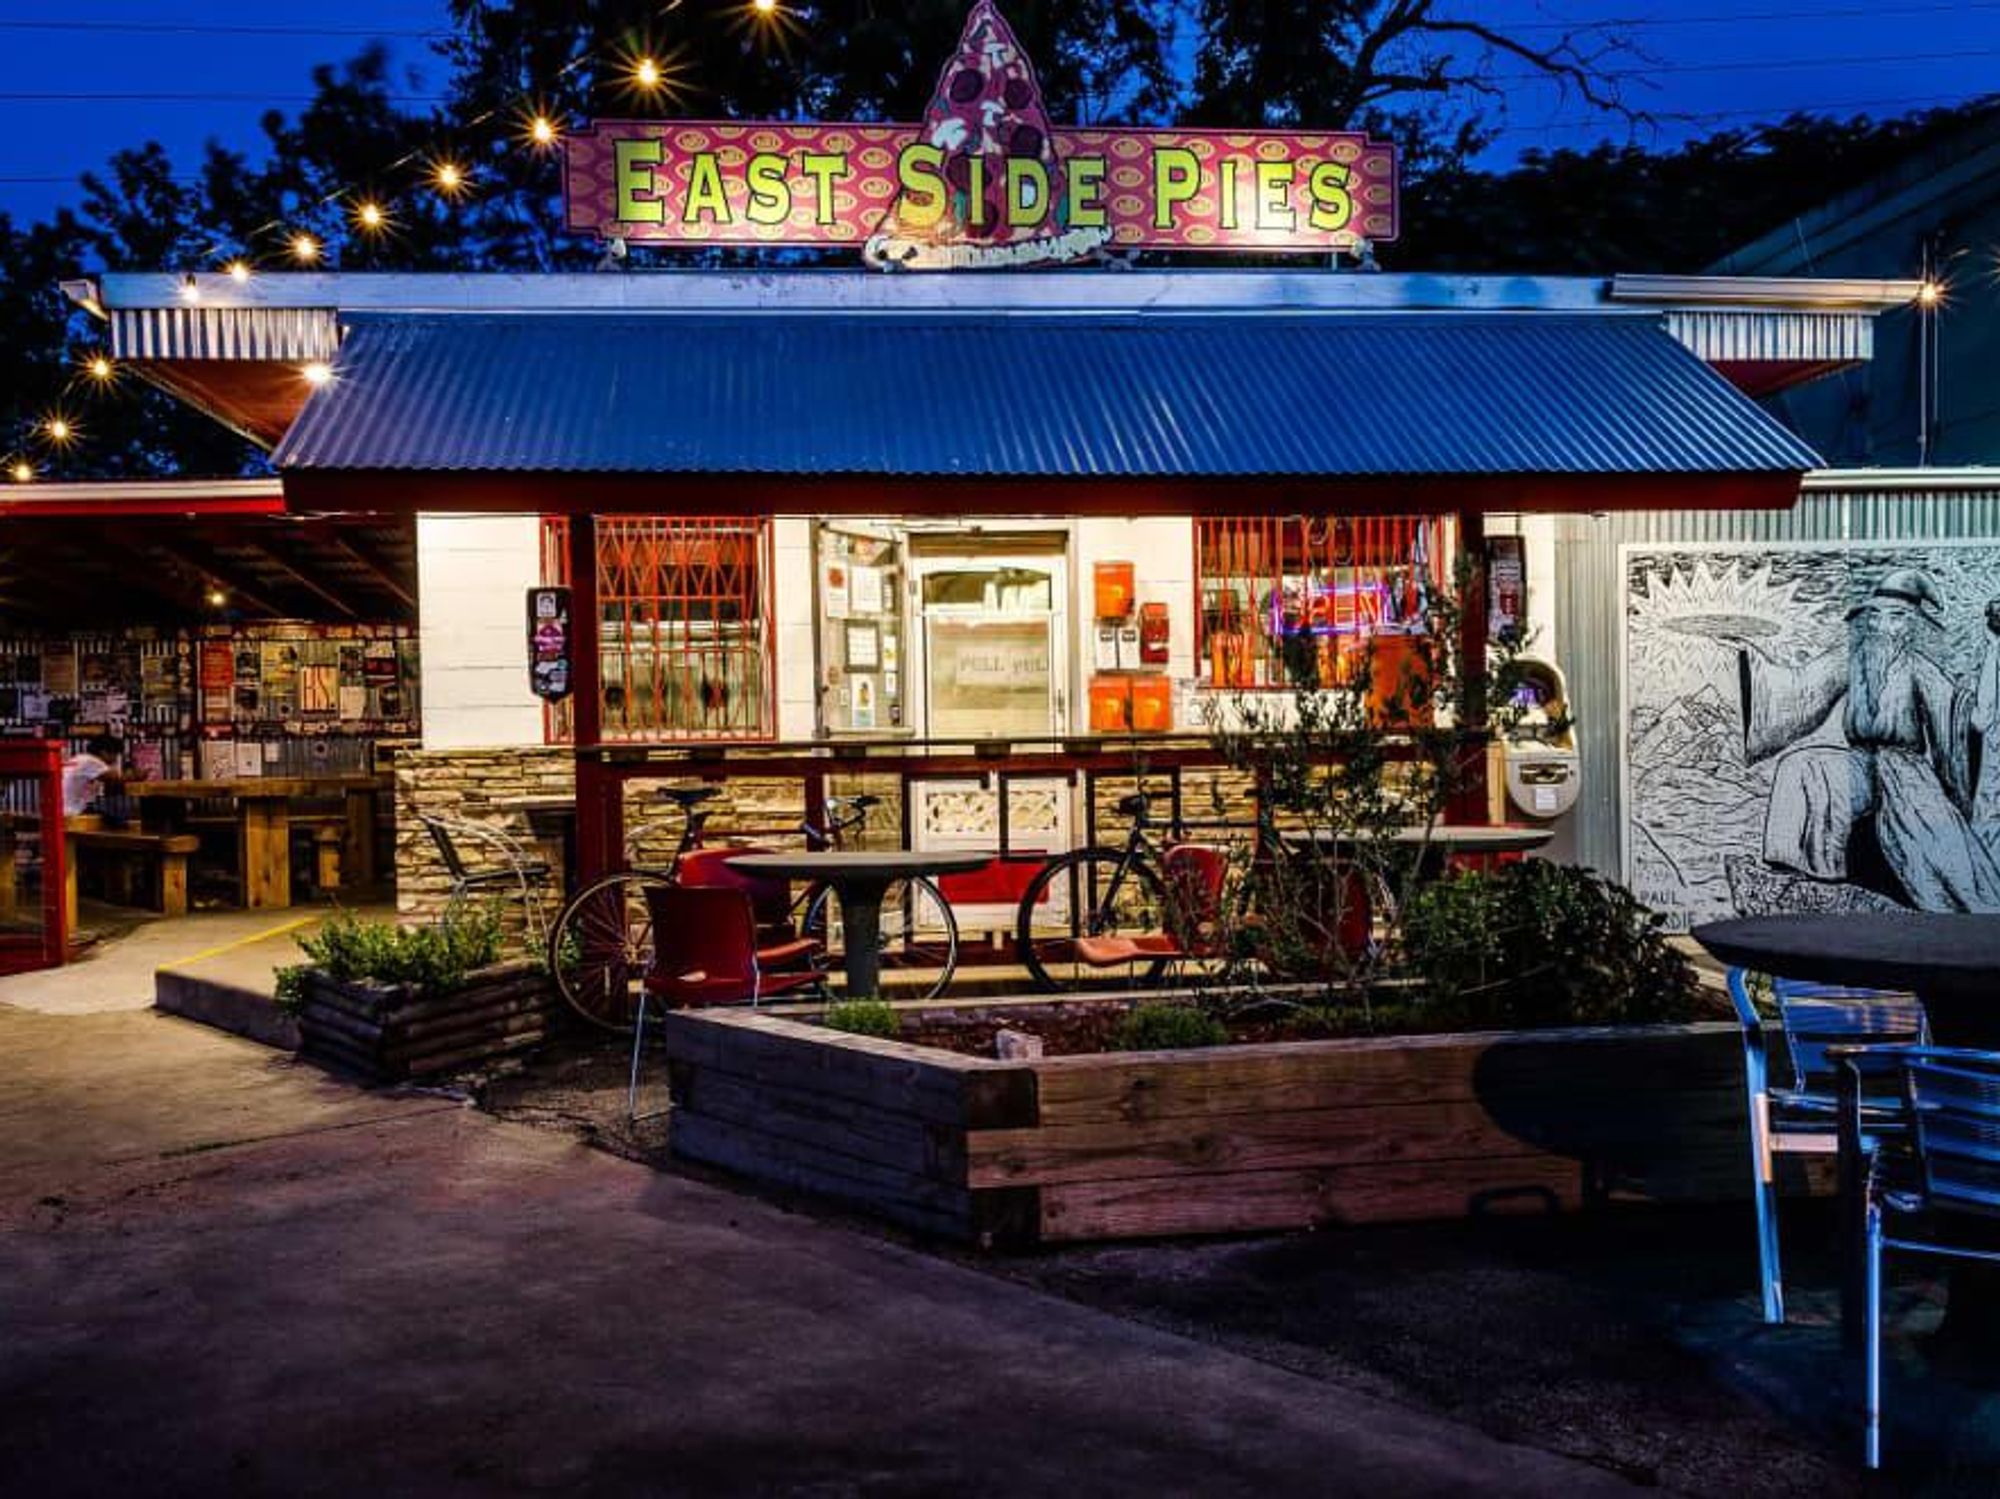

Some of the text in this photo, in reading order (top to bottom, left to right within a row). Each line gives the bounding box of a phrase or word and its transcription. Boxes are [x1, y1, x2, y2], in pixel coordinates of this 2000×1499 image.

[614, 138, 1352, 233] EAST SIDE PIES
